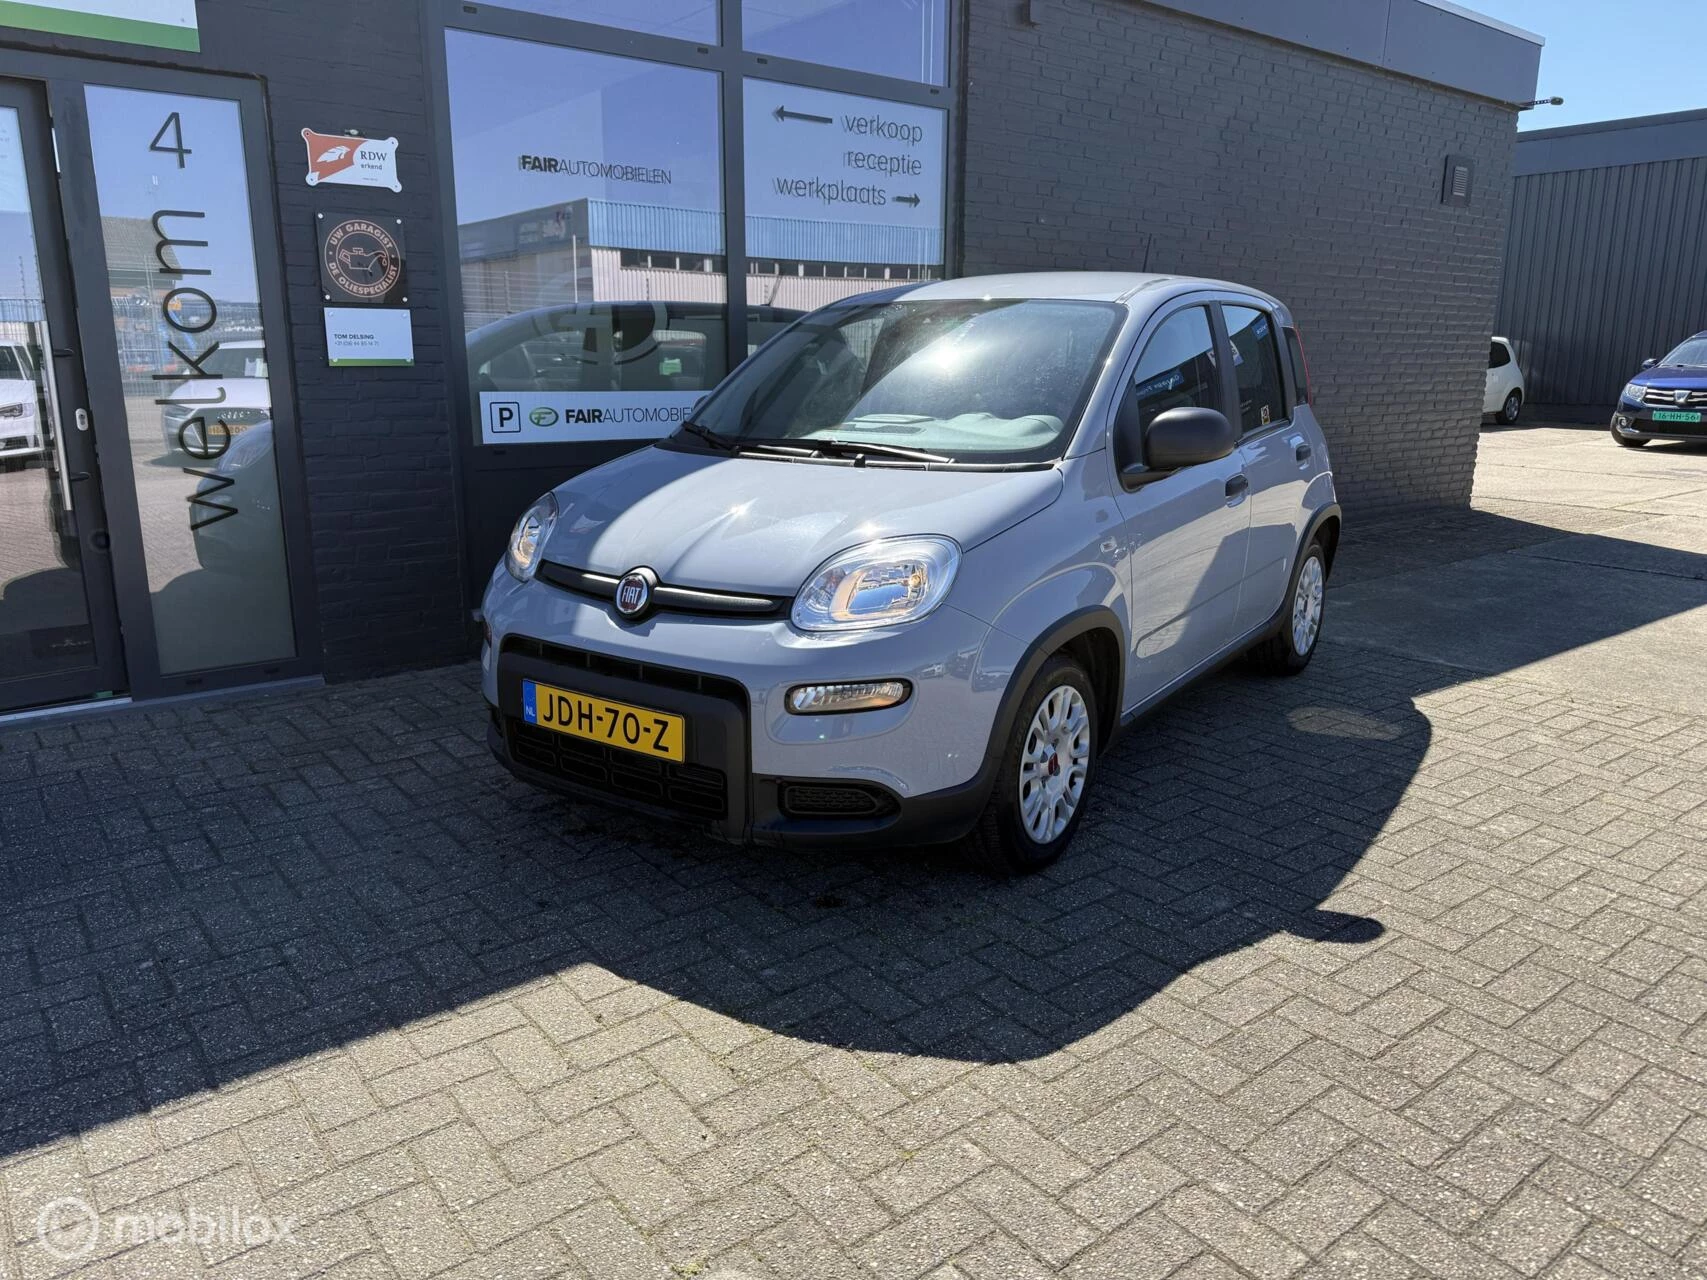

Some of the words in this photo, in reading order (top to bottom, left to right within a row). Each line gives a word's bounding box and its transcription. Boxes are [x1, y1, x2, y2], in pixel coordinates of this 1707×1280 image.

[149, 111, 192, 169] 4
[841, 114, 923, 146] verkoop
[360, 151, 387, 161] RDW
[518, 155, 672, 184] FAIRAUTOMOBIELEN
[844, 150, 922, 177] receptie
[773, 176, 887, 206] werkplaats
[329, 228, 344, 246] UW
[345, 223, 393, 248] GARAGIST
[328, 262, 340, 276] DE
[338, 265, 398, 294] OLIESPECIALIST
[151, 209, 238, 531] welkom
[499, 407, 513, 428] P
[565, 407, 693, 424] FAIRAUTOMOBIE
[621, 585, 641, 605] FIAT
[525, 704, 536, 717] NL
[543, 693, 669, 753] JDH-70-Z
